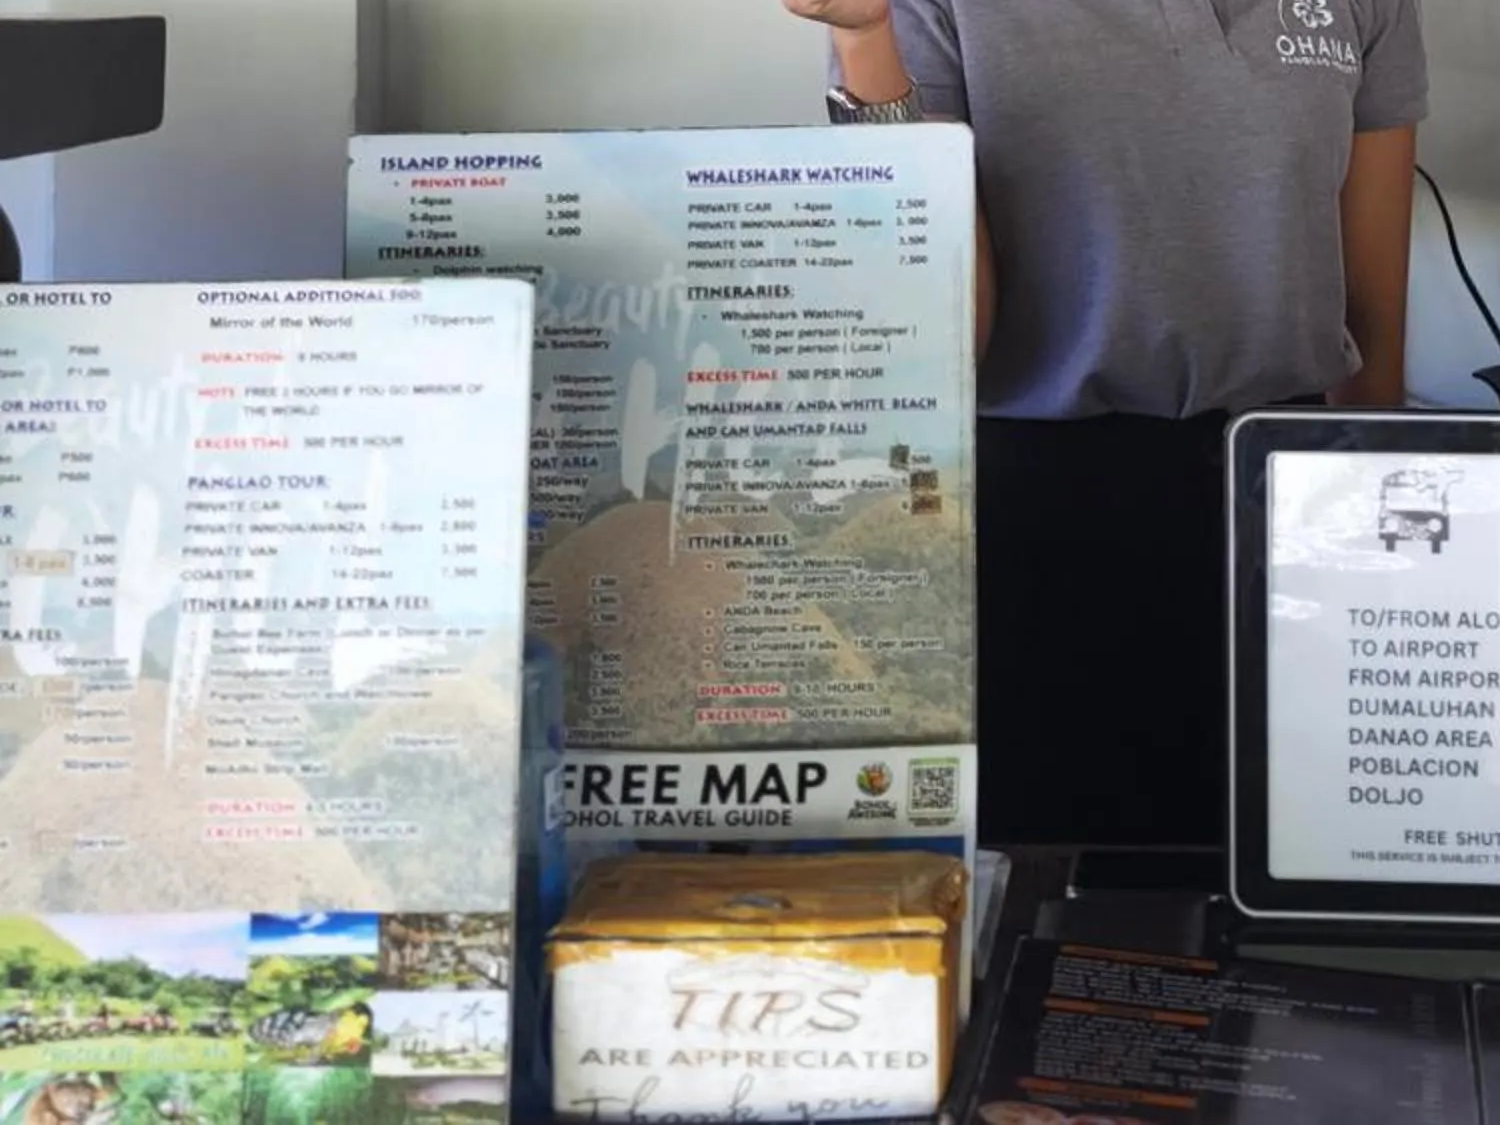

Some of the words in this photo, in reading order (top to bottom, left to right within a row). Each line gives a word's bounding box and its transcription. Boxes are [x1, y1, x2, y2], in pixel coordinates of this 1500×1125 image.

[1276, 35, 1356, 64] OHANA
[381, 156, 448, 171] ISLAND
[454, 154, 543, 169] HOPPING
[411, 178, 466, 188] PRIVATE
[686, 169, 801, 184] WHALESHARK
[806, 166, 894, 182] WATCHING
[688, 203, 740, 213] PRIVATE
[744, 203, 772, 213] CAR
[688, 221, 736, 230] PRIVATE
[688, 239, 736, 249] PRIVATE
[433, 264, 483, 276] Dolphin
[688, 259, 736, 269] PRIVATE
[740, 258, 797, 268] COASTER
[6, 292, 29, 305] OR
[34, 292, 86, 305] HOTEL
[91, 292, 112, 305] TO
[197, 291, 280, 304] OPTIONAL
[284, 290, 385, 303] ADDITIONAL
[210, 316, 255, 328] Mirror
[259, 316, 276, 328] of
[280, 316, 303, 327] the
[309, 316, 353, 328] World
[721, 310, 798, 320] Whaleshark
[803, 309, 864, 321] Watching
[775, 330, 795, 340] per
[798, 328, 840, 340] person
[775, 344, 794, 355] per
[798, 343, 839, 354] person
[687, 371, 736, 383] EXCESS
[742, 370, 778, 382] TIME
[814, 369, 840, 380] PER
[845, 368, 884, 379] HOUR
[30, 400, 80, 411] HOTEL
[87, 399, 107, 411] TO
[686, 401, 783, 414] WHALESHARK
[796, 399, 836, 412] ANDA
[841, 398, 886, 411] WHITE
[892, 397, 937, 409] BEACH
[686, 425, 717, 438] AND
[187, 476, 272, 491] PANGLAO
[182, 598, 287, 612] ITINERARIES
[294, 597, 330, 611] AND
[336, 596, 389, 611] EXTRA
[1348, 607, 1451, 630] TO/FROM
[1348, 638, 1379, 659] TO
[1383, 639, 1479, 659] AIRPORT
[1348, 668, 1415, 688] FROM
[1348, 697, 1496, 719] DUMALUHAN
[1348, 727, 1430, 748] DANAO
[1435, 728, 1493, 749] AREA
[1348, 756, 1479, 778] POBLACION
[701, 761, 828, 805] MAP
[1348, 786, 1424, 807] DOLJO
[632, 809, 716, 828] TRAVEL
[724, 809, 793, 827] GUIDE
[1404, 829, 1448, 846] FREE
[1350, 849, 1376, 861] THIS
[1378, 850, 1425, 863] SERVICE
[1427, 851, 1437, 863] IS
[1439, 852, 1491, 865] SUBJECT
[669, 989, 863, 1032] TIPS
[578, 1047, 652, 1068] ARE
[667, 1047, 929, 1071] APPRECIATED
[570, 1076, 764, 1125] Thank
[787, 1089, 890, 1119] you
